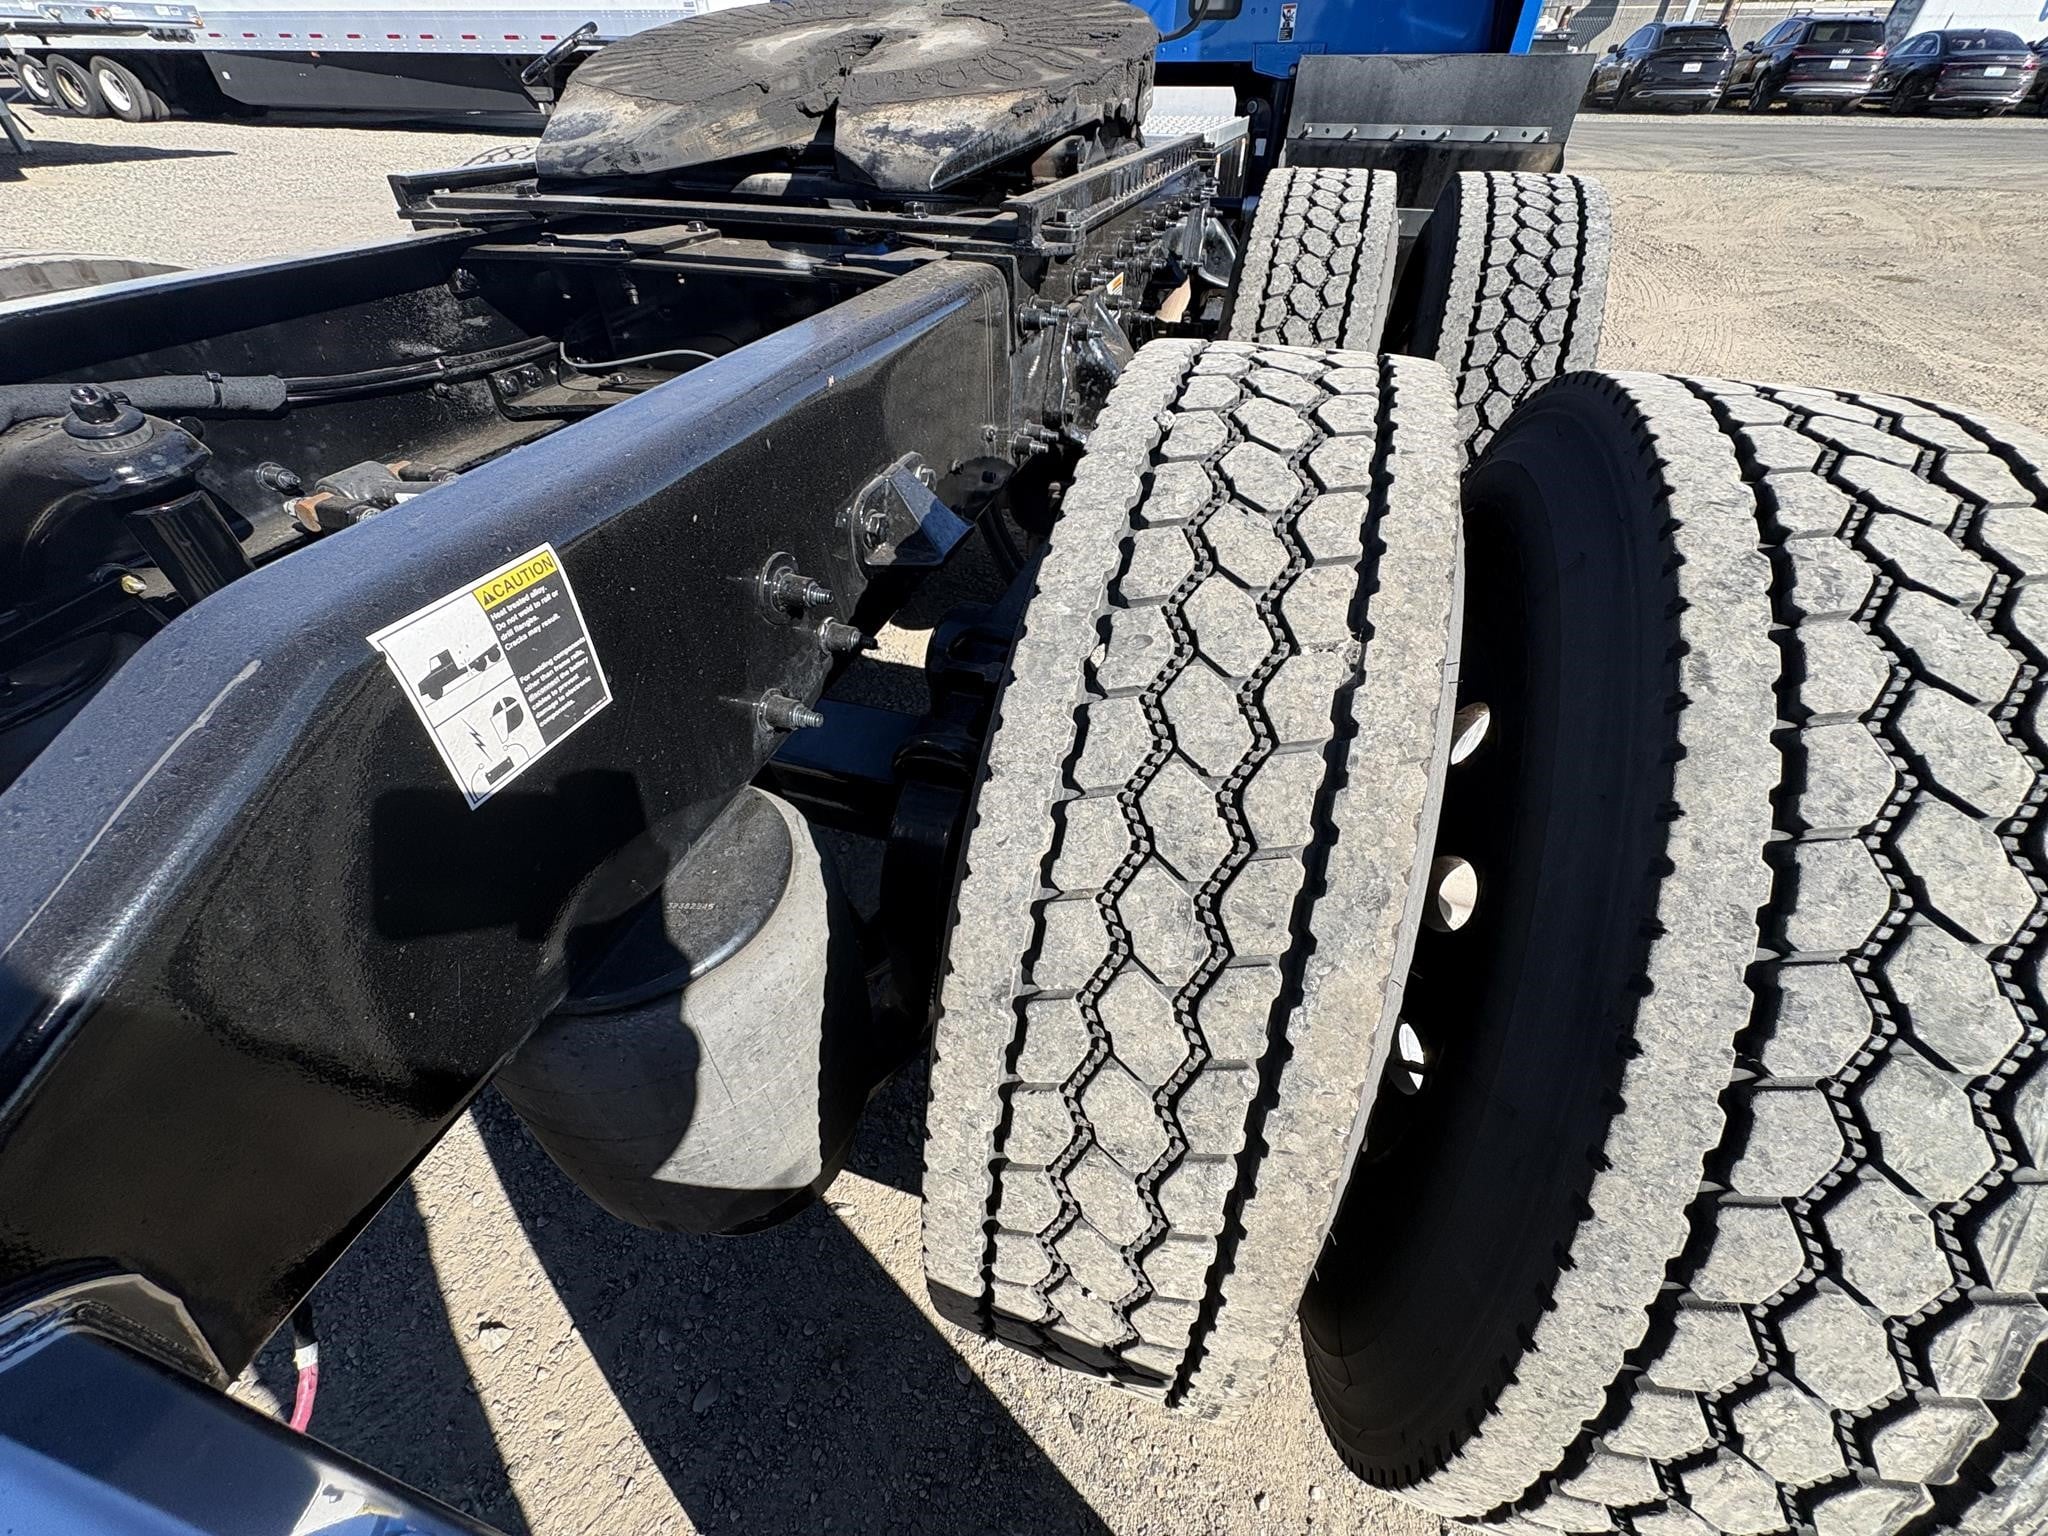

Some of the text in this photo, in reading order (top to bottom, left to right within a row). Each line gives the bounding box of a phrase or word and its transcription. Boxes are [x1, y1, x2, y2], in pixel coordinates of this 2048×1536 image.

[493, 556, 554, 597] CAUTION
[490, 586, 547, 621] Heat treated alloy.
[496, 622, 506, 631] Do
[507, 614, 518, 625] not
[518, 604, 534, 617] weld
[541, 594, 552, 604] rail
[500, 628, 515, 641] drill
[505, 613, 560, 650] Cracks may result.
[519, 637, 585, 684] For welding components
[524, 679, 540, 693] other
[540, 670, 554, 681] than
[554, 658, 571, 672] frame
[528, 657, 588, 702] disconnect the battery
[532, 694, 551, 710] cables
[558, 673, 580, 693] prevent
[536, 700, 558, 718] damage
[565, 676, 592, 697] electronic
[539, 700, 575, 727] components.
